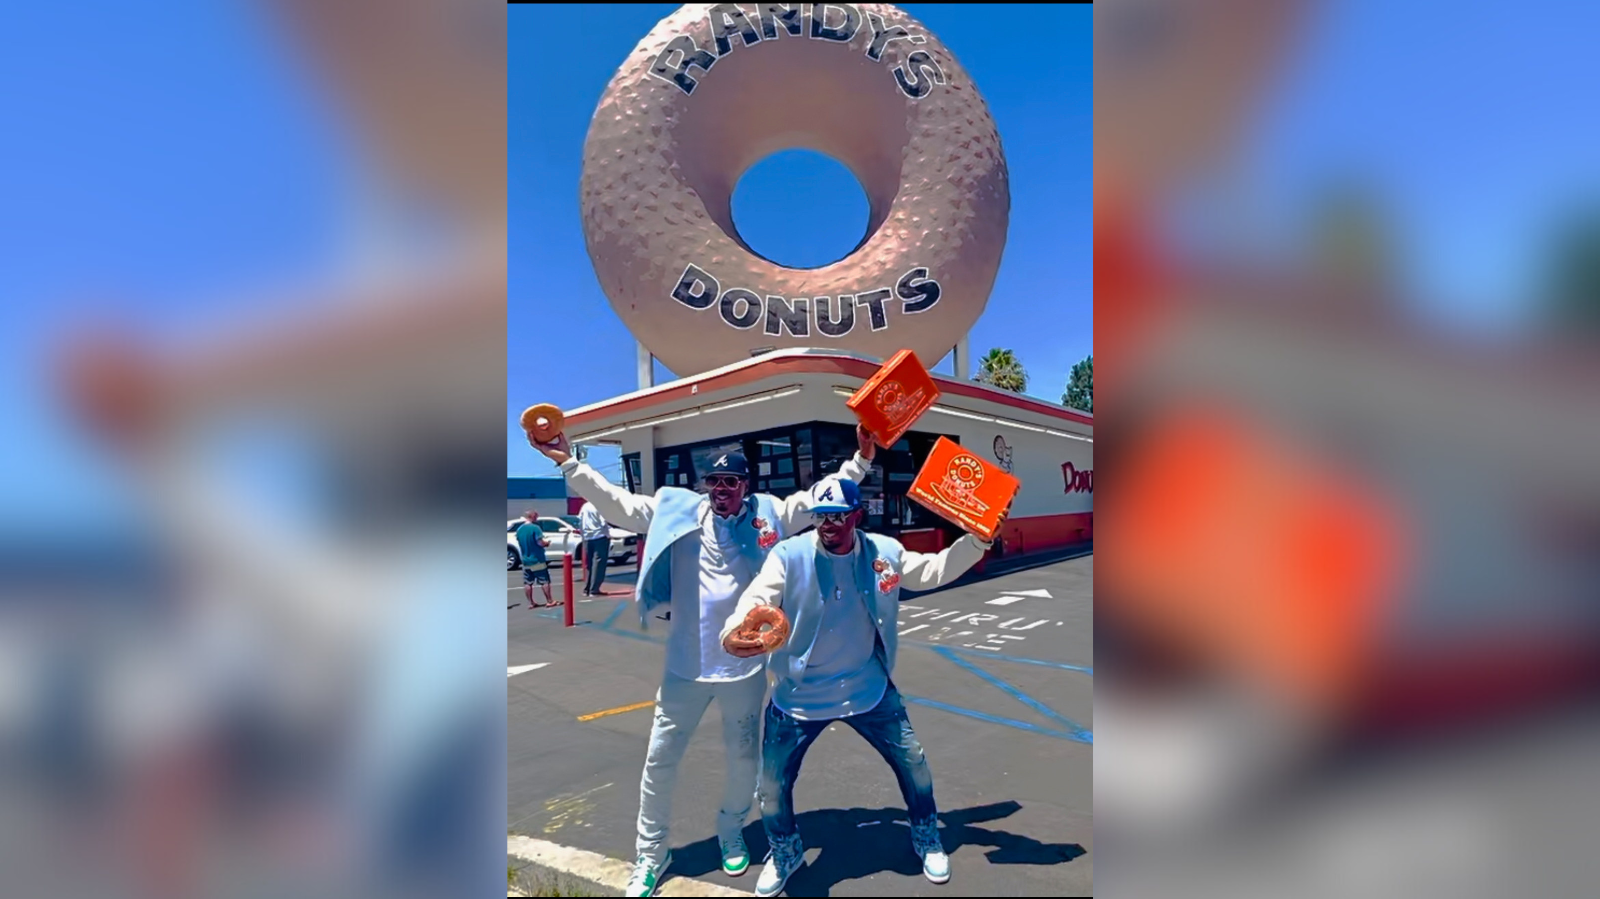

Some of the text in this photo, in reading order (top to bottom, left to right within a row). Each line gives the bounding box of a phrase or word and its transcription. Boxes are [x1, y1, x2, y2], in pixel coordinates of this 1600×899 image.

[648, 3, 946, 99] RANDY'S
[670, 263, 941, 337] DONUTS
[950, 469, 976, 488] DONUTS
[954, 457, 982, 479] RANDY'S
